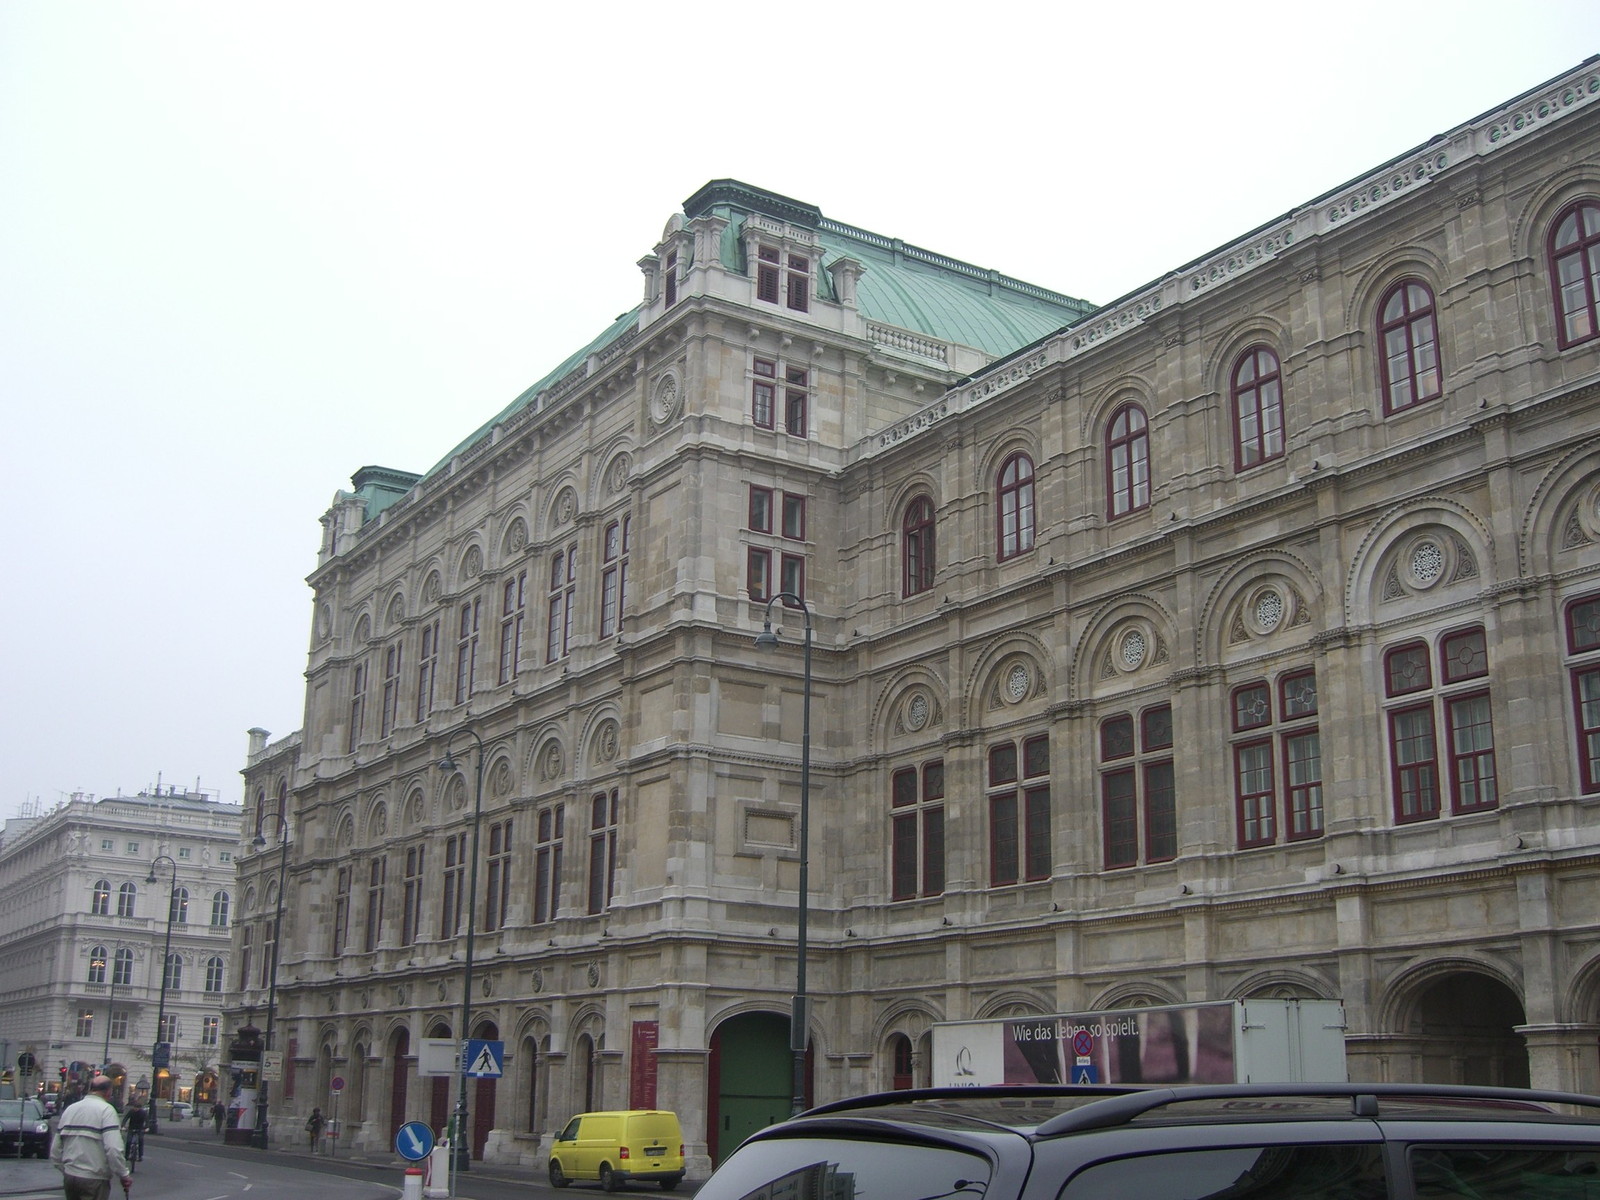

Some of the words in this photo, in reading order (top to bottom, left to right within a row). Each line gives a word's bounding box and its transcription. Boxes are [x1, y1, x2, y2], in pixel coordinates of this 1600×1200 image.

[1012, 1025, 1032, 1041] Wie
[1034, 1023, 1052, 1040] das
[1090, 1024, 1102, 1038] so
[1106, 1016, 1139, 1042] spielt.
